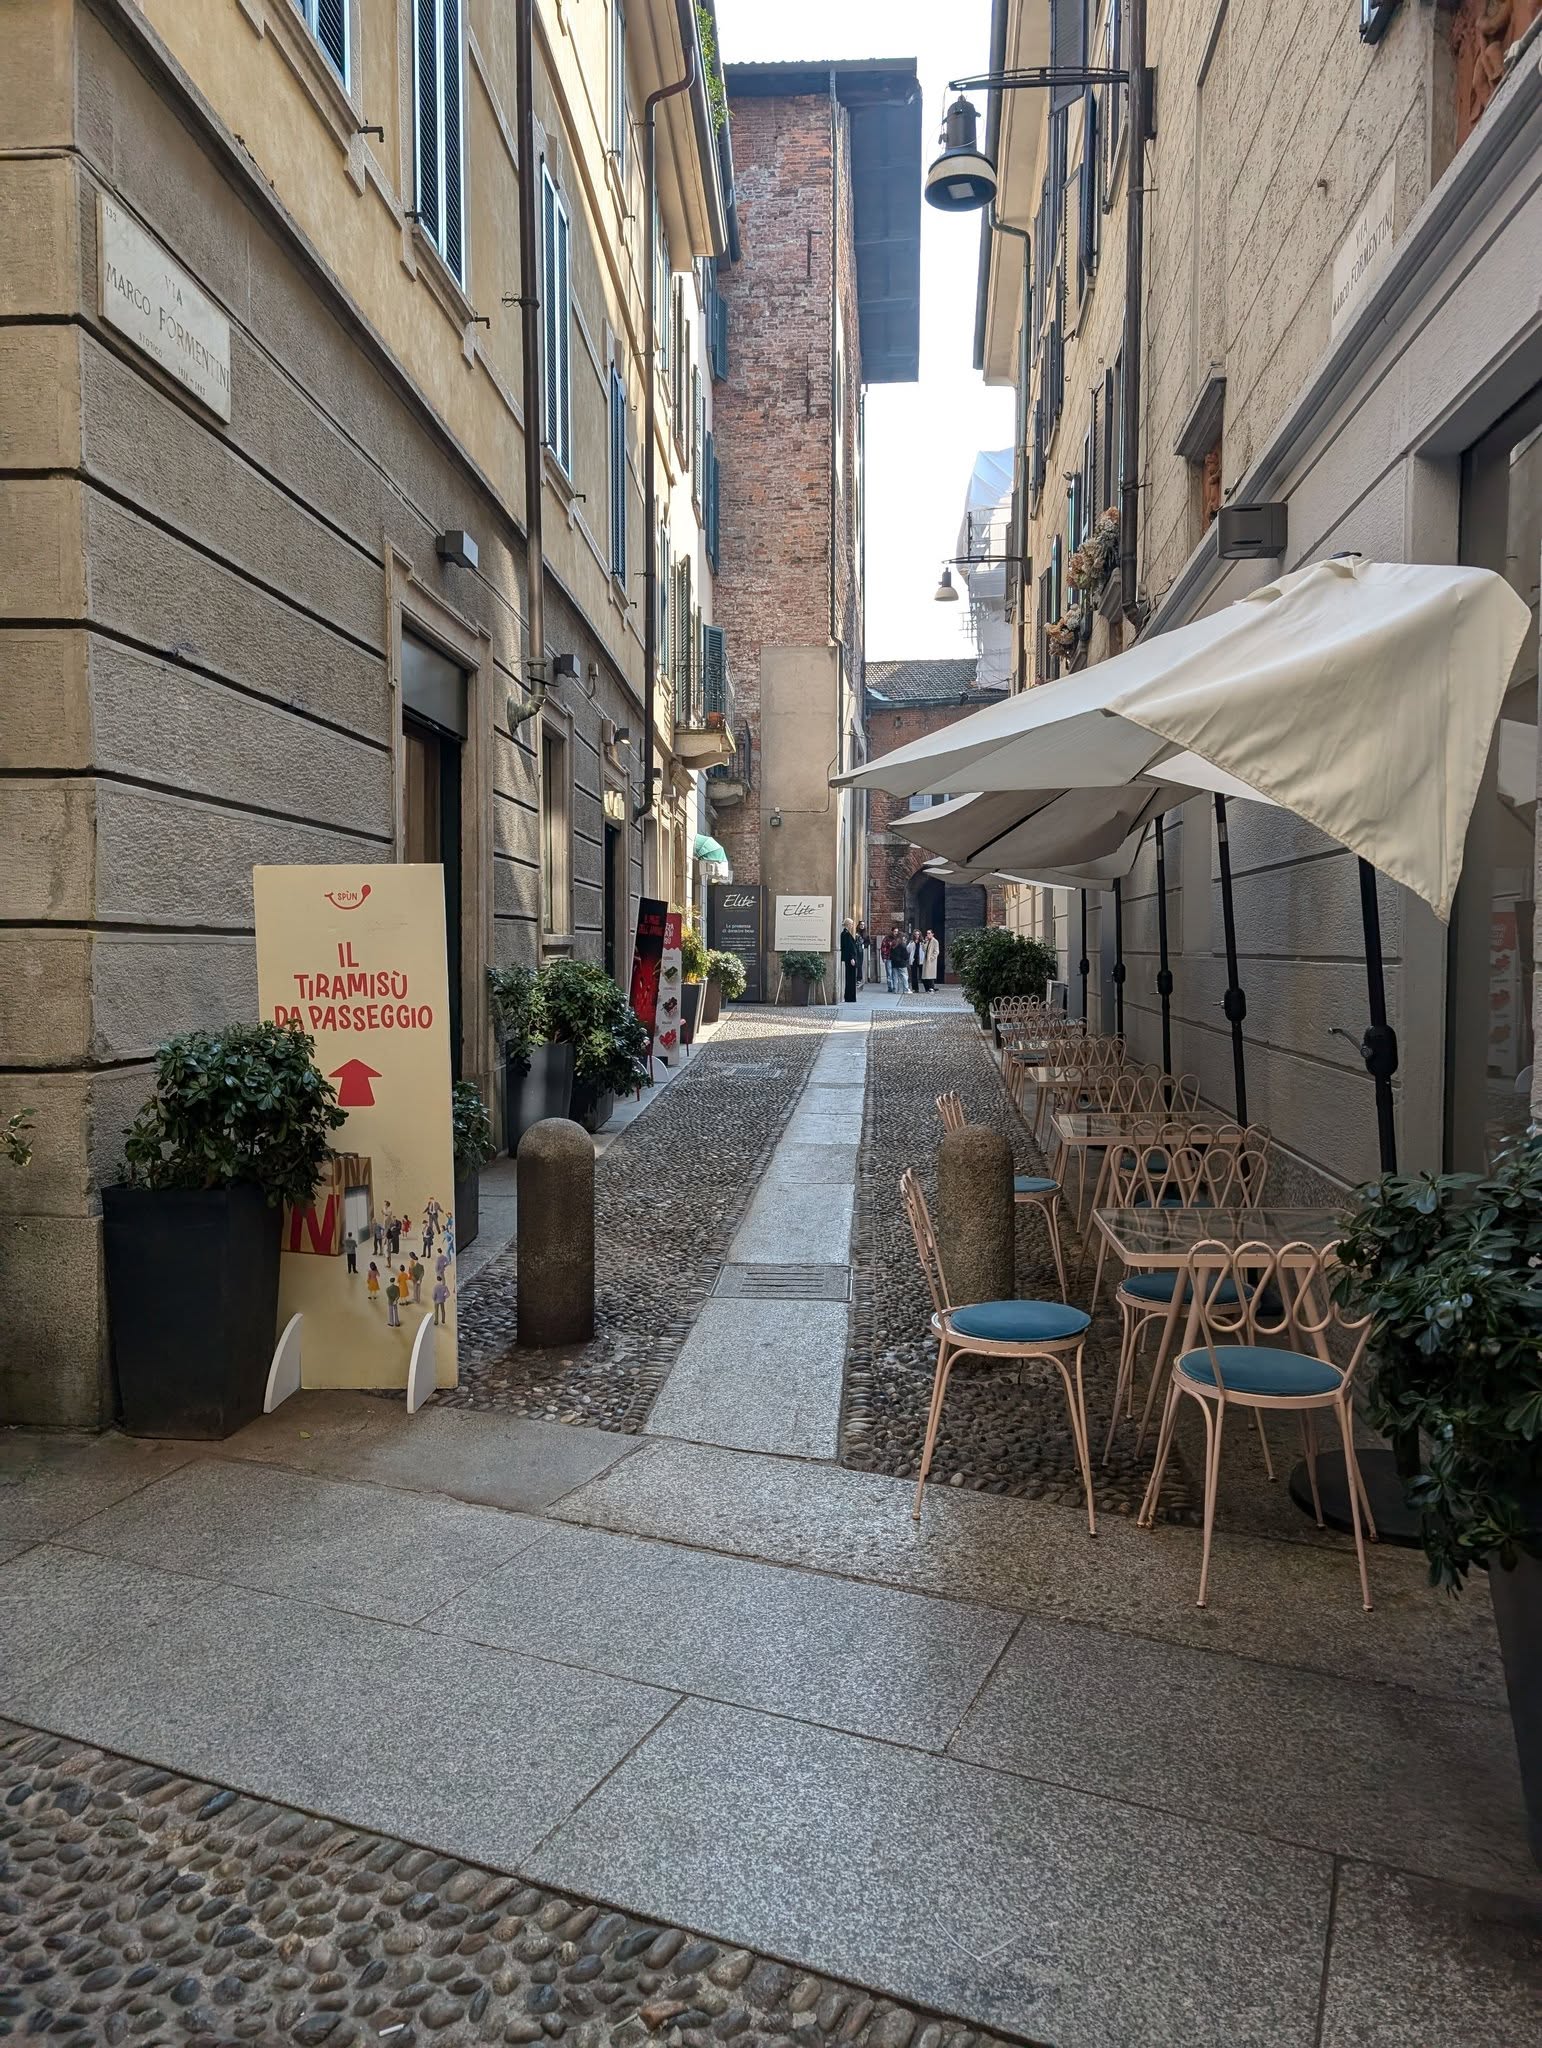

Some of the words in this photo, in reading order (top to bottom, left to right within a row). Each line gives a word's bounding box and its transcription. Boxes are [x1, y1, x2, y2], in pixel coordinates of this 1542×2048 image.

[1356, 217, 1368, 248] VIA
[1332, 280, 1350, 320] MARCO
[1351, 204, 1392, 290] FORMENTINI
[164, 275, 183, 307] VIA
[106, 262, 151, 316] MARCO
[159, 306, 230, 393] FORMENTINI
[138, 332, 163, 358] STORICO
[337, 890, 358, 901] SPÙN
[337, 941, 359, 968] IL
[293, 970, 408, 1001] TIRAMISÙ
[274, 1005, 305, 1032] DA
[308, 1004, 433, 1032] PASSEGGIO
